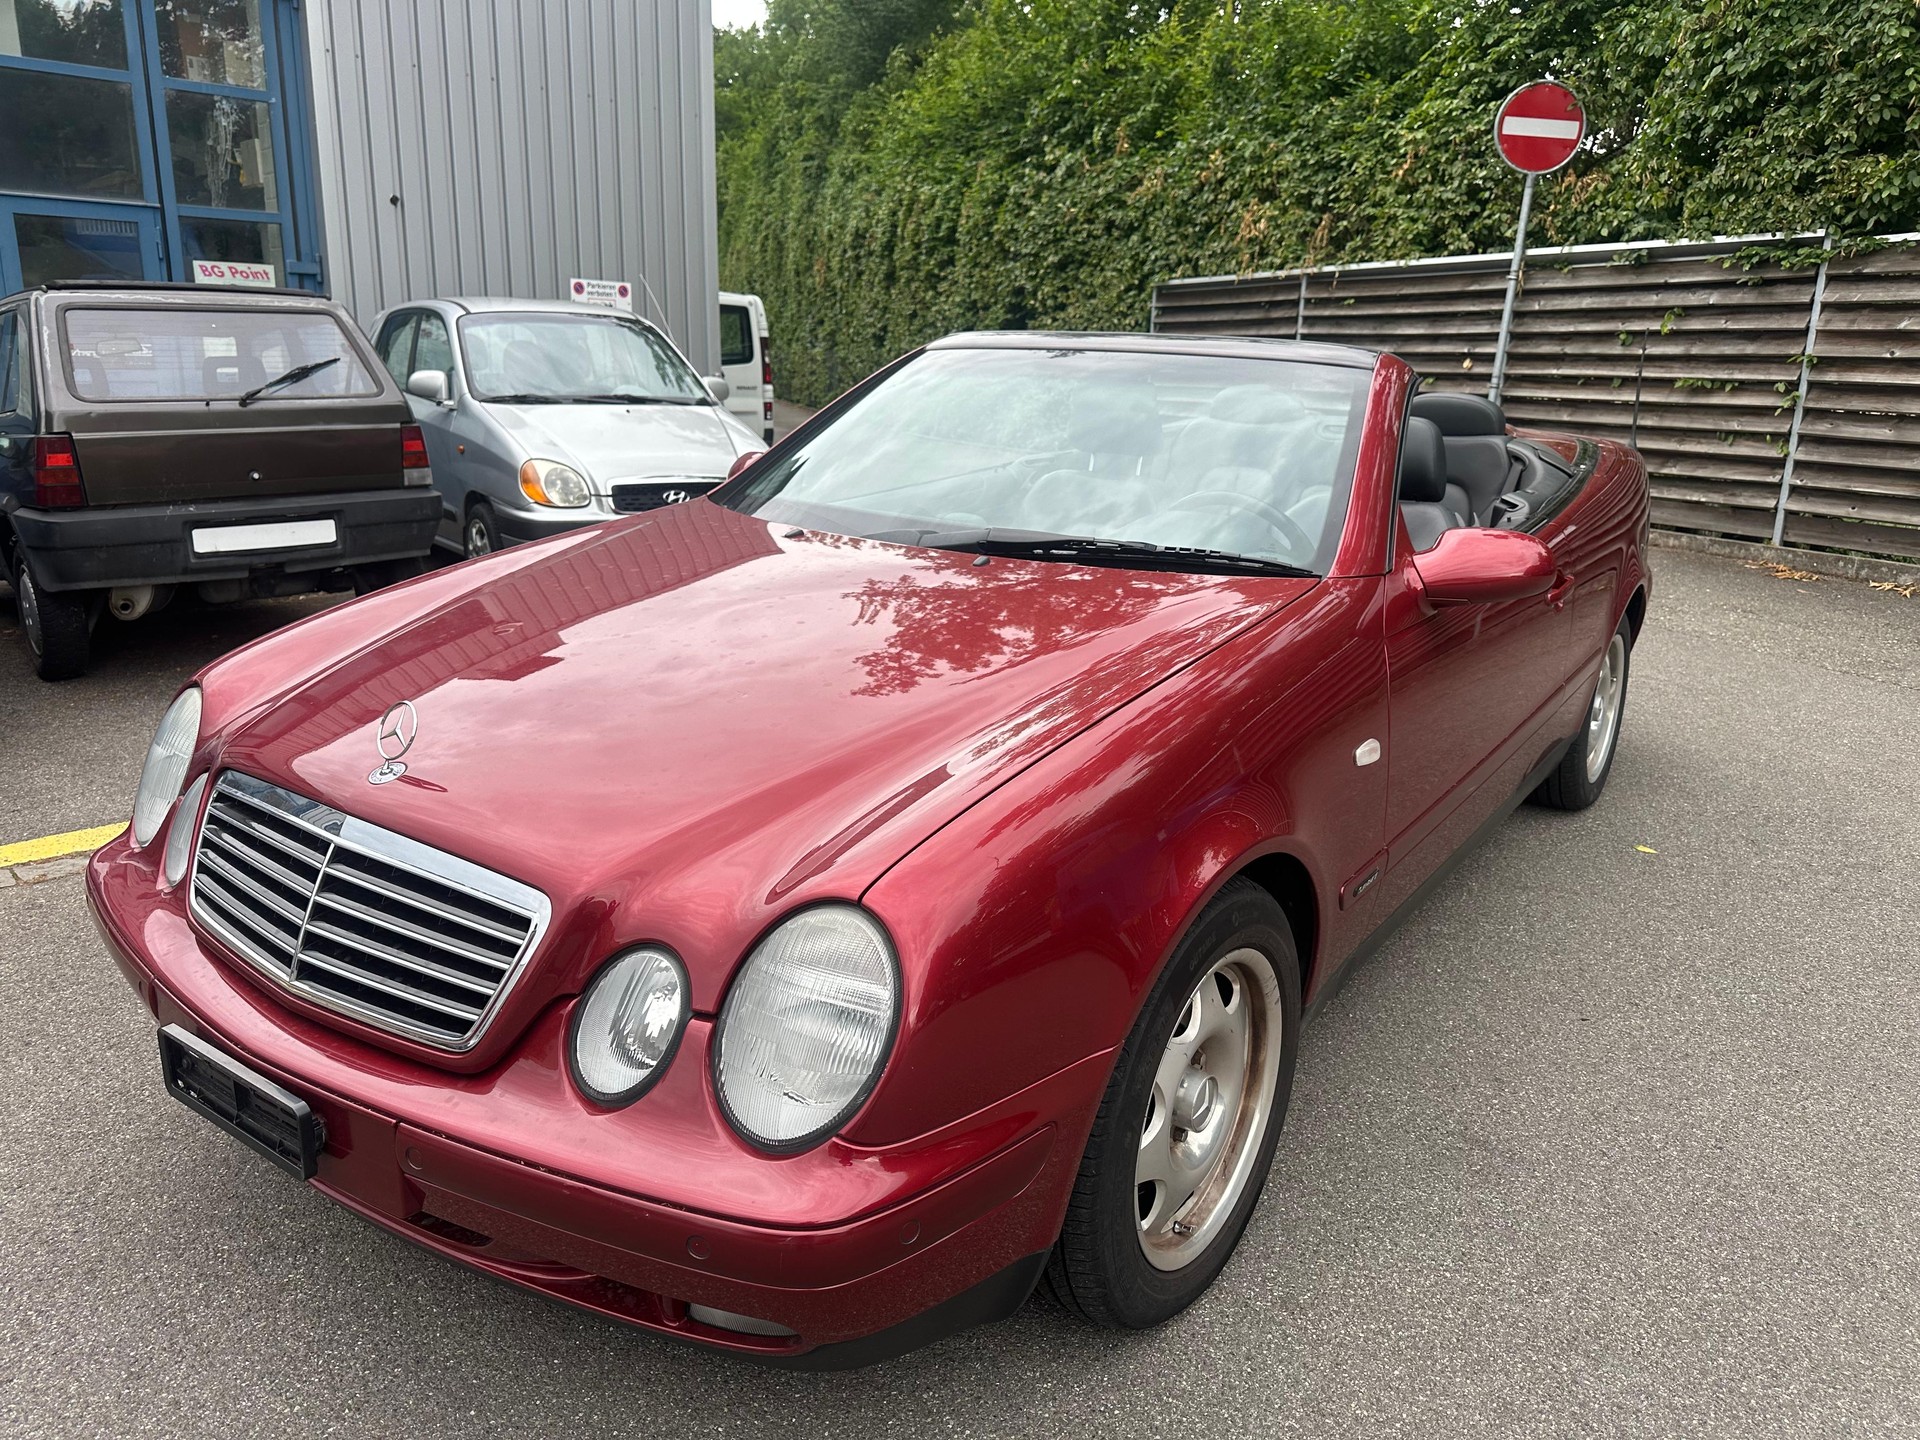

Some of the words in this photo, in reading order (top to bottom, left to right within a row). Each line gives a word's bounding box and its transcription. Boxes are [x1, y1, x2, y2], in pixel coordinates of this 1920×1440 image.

[198, 264, 225, 278] BG
[227, 265, 270, 280] Point
[587, 281, 616, 290] Parkieren
